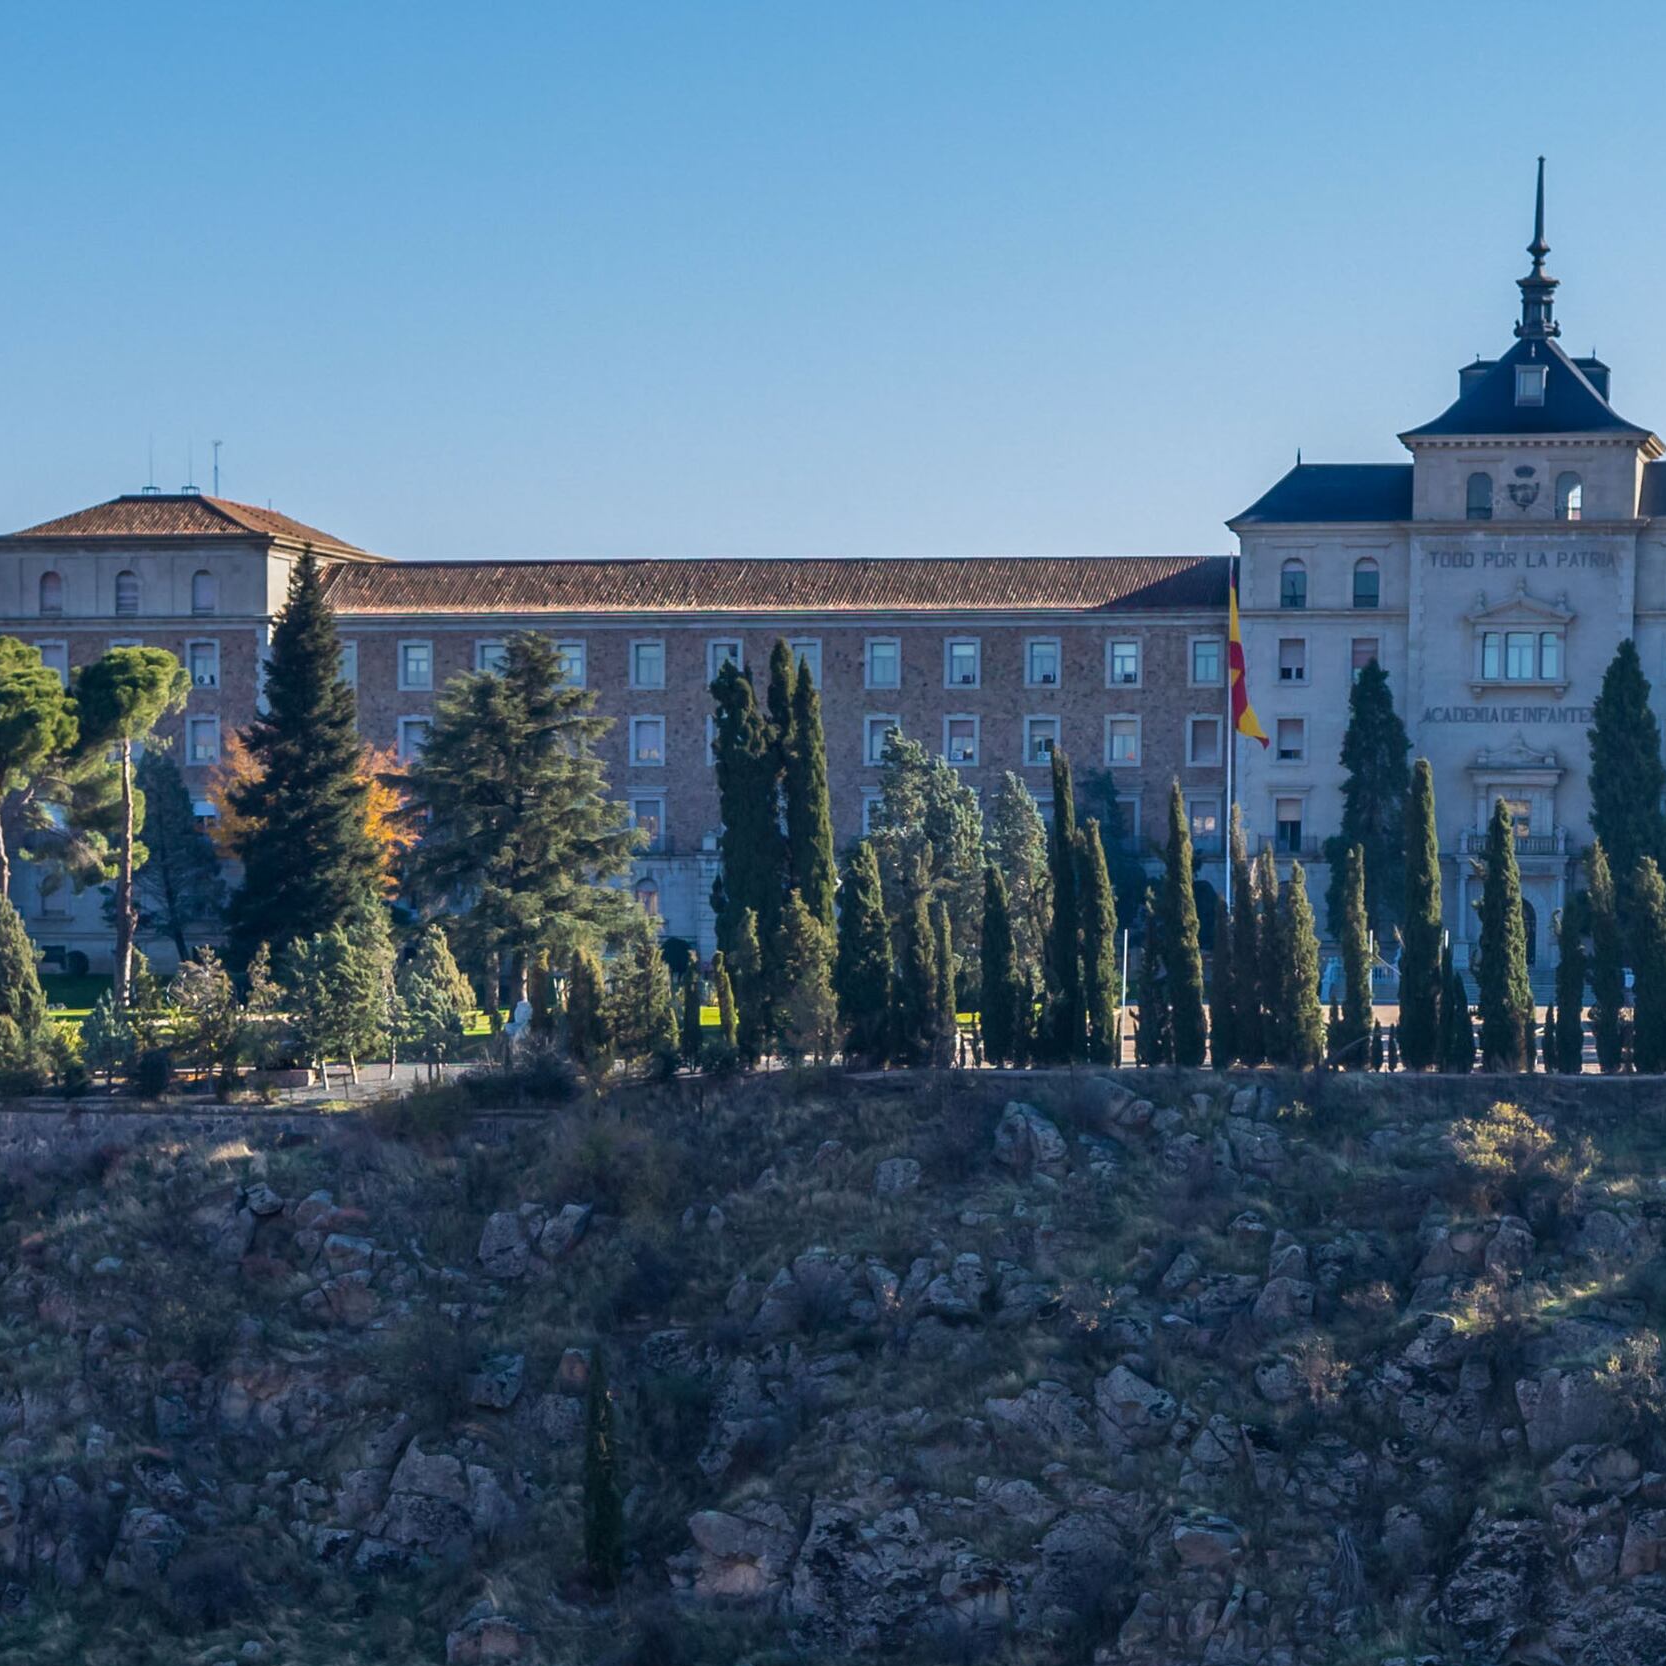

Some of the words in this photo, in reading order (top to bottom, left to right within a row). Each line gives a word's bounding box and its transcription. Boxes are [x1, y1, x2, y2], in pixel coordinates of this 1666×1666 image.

[1429, 551, 1475, 568] TODO
[1483, 551, 1517, 568] POR
[1525, 551, 1548, 568] LA
[1556, 551, 1616, 568] PATRIA
[1421, 706, 1499, 723] ACADEMIA
[1501, 706, 1522, 723] DE
[1523, 706, 1596, 723] INFANTE
